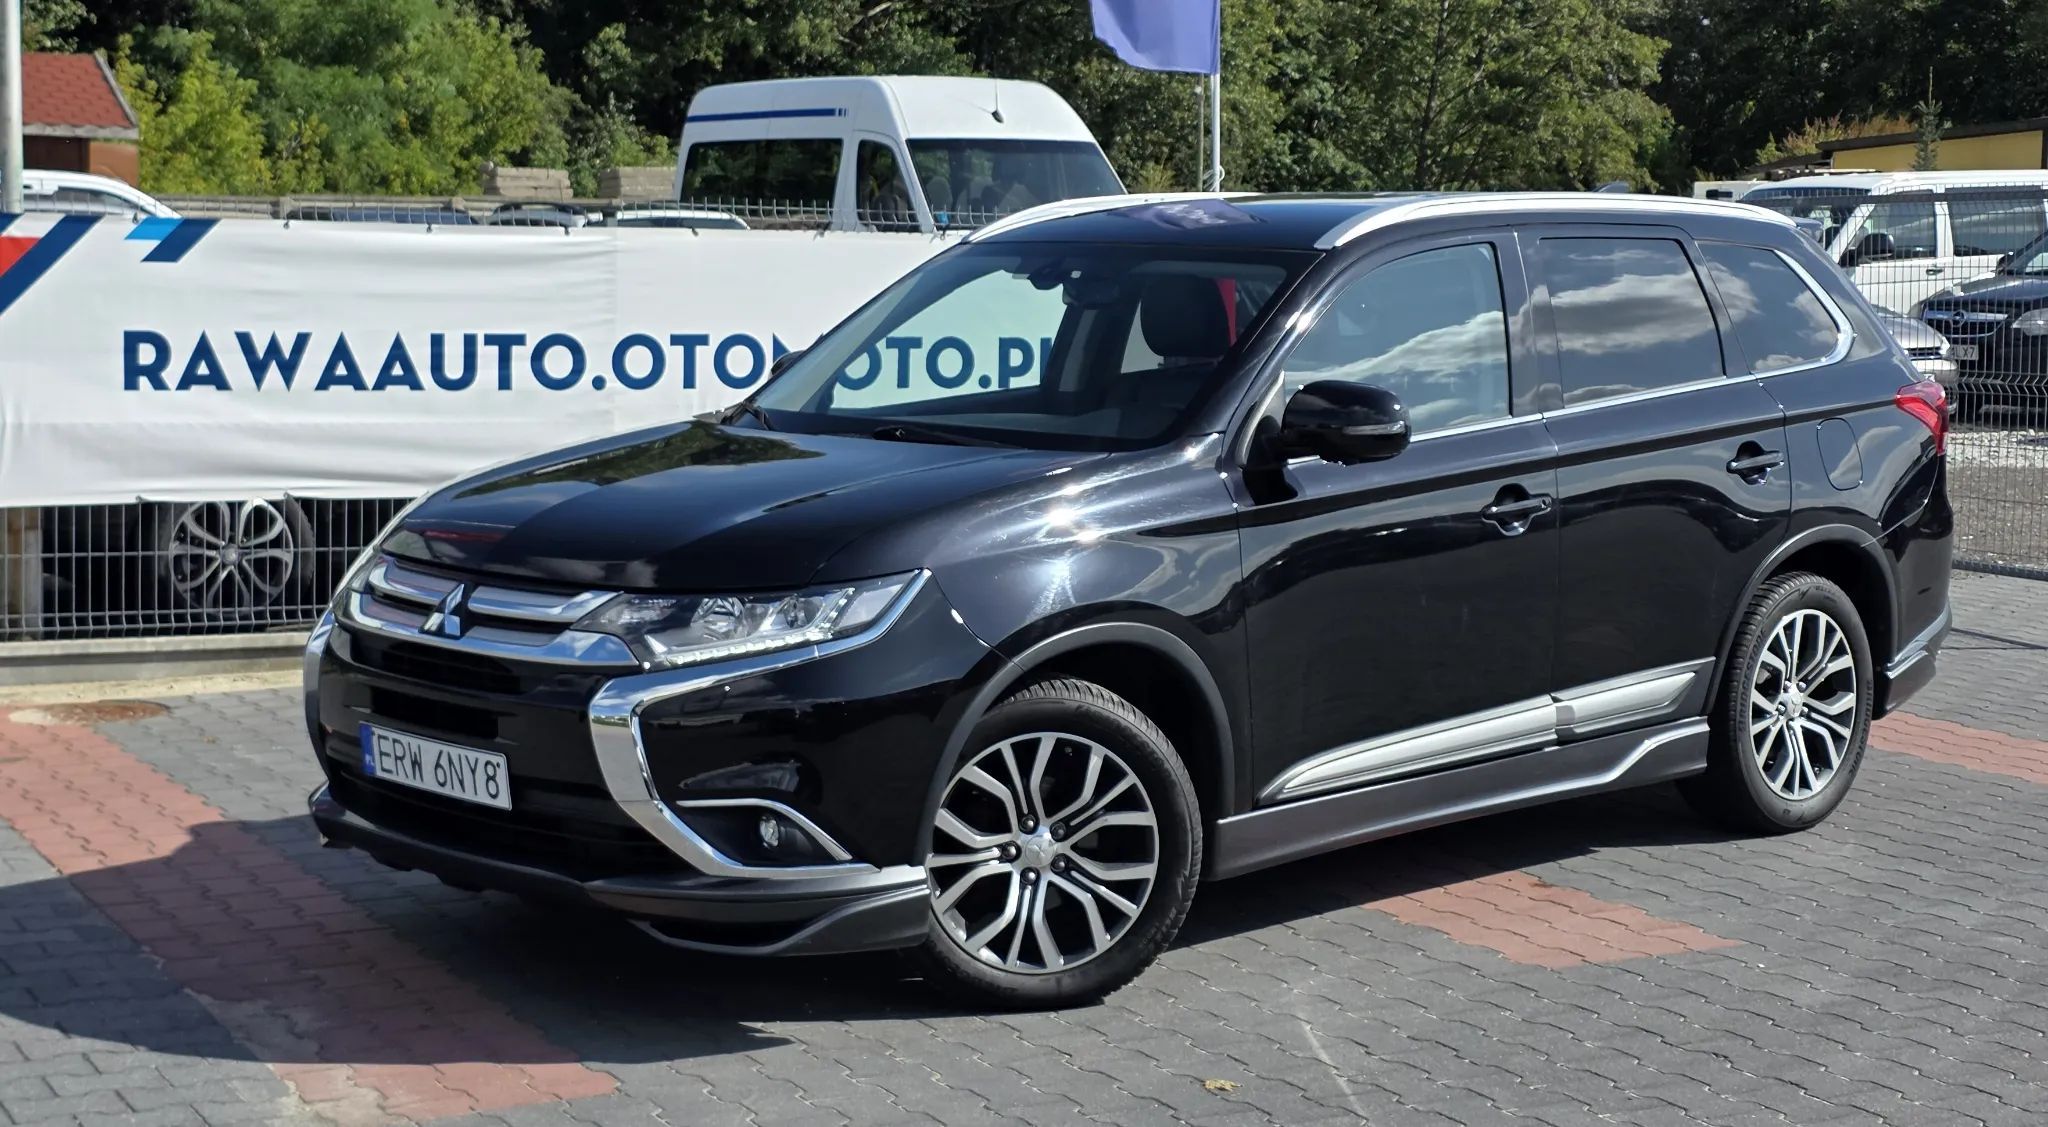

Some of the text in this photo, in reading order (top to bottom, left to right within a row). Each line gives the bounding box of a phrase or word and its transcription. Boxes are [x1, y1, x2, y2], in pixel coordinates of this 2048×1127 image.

[122, 329, 1051, 392] RAWAAUTO.OTOOTO.P
[377, 735, 500, 800] ERW 6NY8
